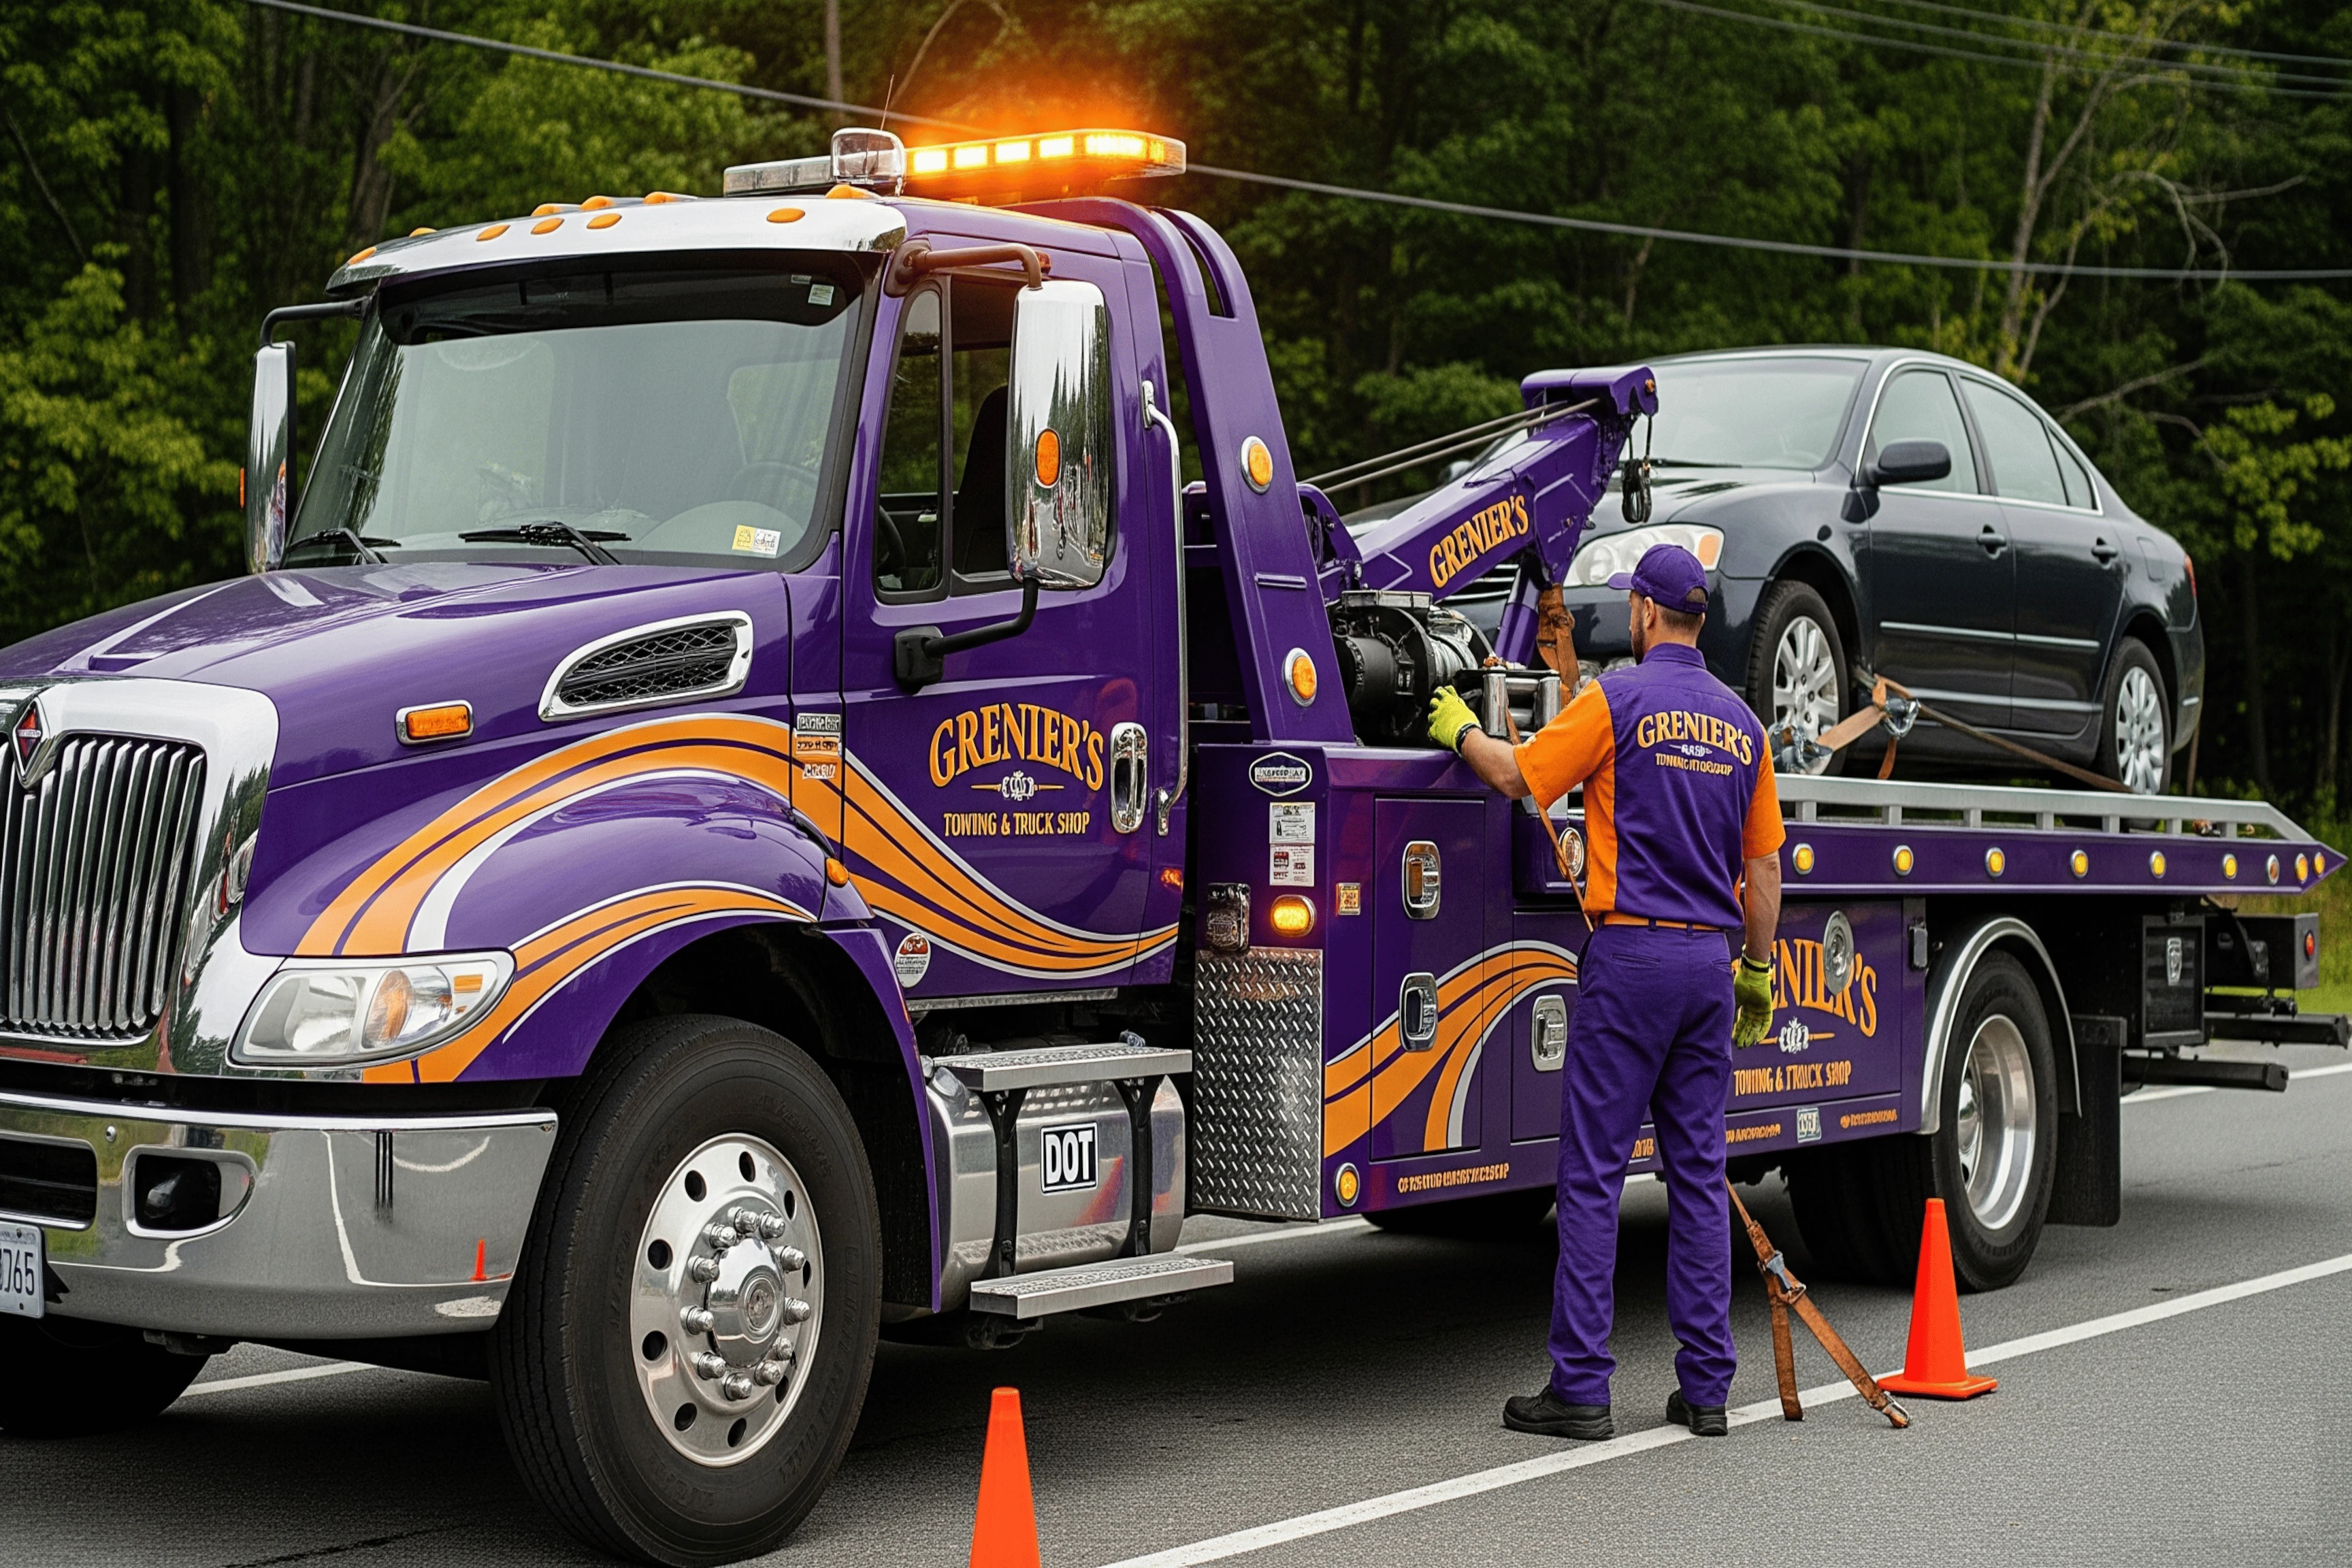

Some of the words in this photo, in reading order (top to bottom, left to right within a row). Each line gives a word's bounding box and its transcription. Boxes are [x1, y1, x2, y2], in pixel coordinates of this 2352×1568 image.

[1429, 494, 1529, 589] GRENIER'S
[929, 702, 1104, 791] GRENIER'S
[1637, 710, 1752, 766] GRENIER'S
[1001, 813, 1011, 836] &
[1013, 812, 1054, 836] TRUCK
[1058, 811, 1090, 835] SHOP
[1731, 938, 1878, 1038] NIER'S
[1045, 1129, 1093, 1184] DOT
[0, 1247, 35, 1296] 765
